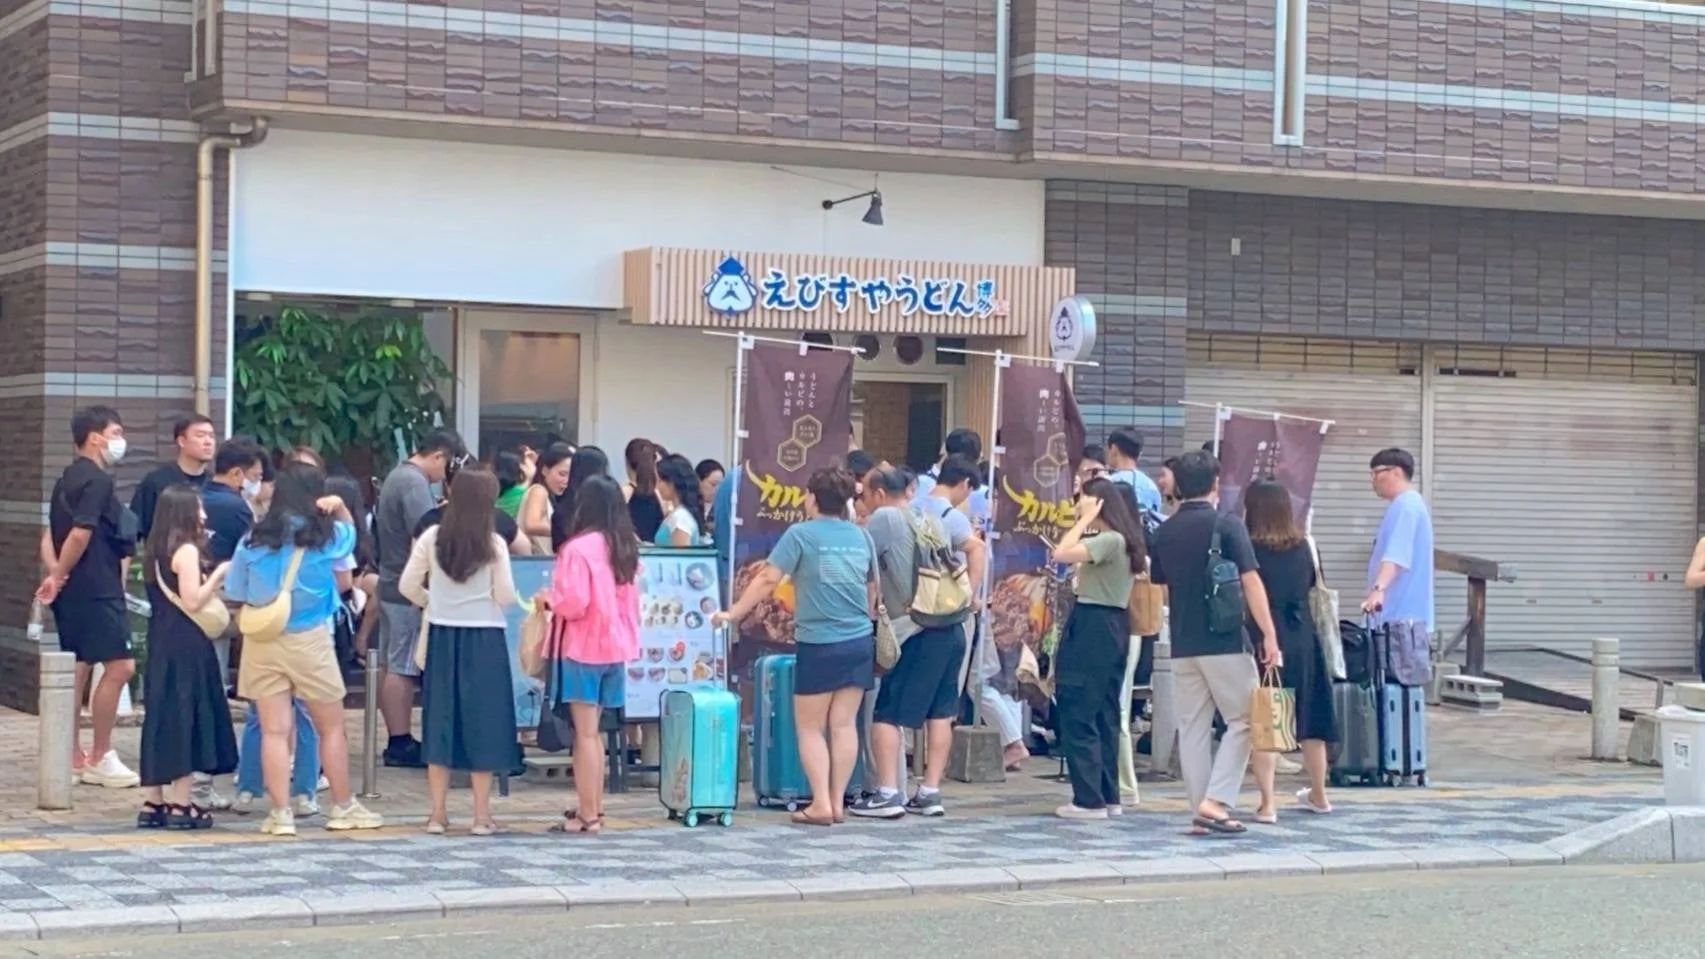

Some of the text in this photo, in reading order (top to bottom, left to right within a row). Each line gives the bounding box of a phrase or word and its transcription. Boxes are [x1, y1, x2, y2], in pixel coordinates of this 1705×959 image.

[761, 268, 974, 316] えびすやうどん
[750, 466, 807, 508] カル
